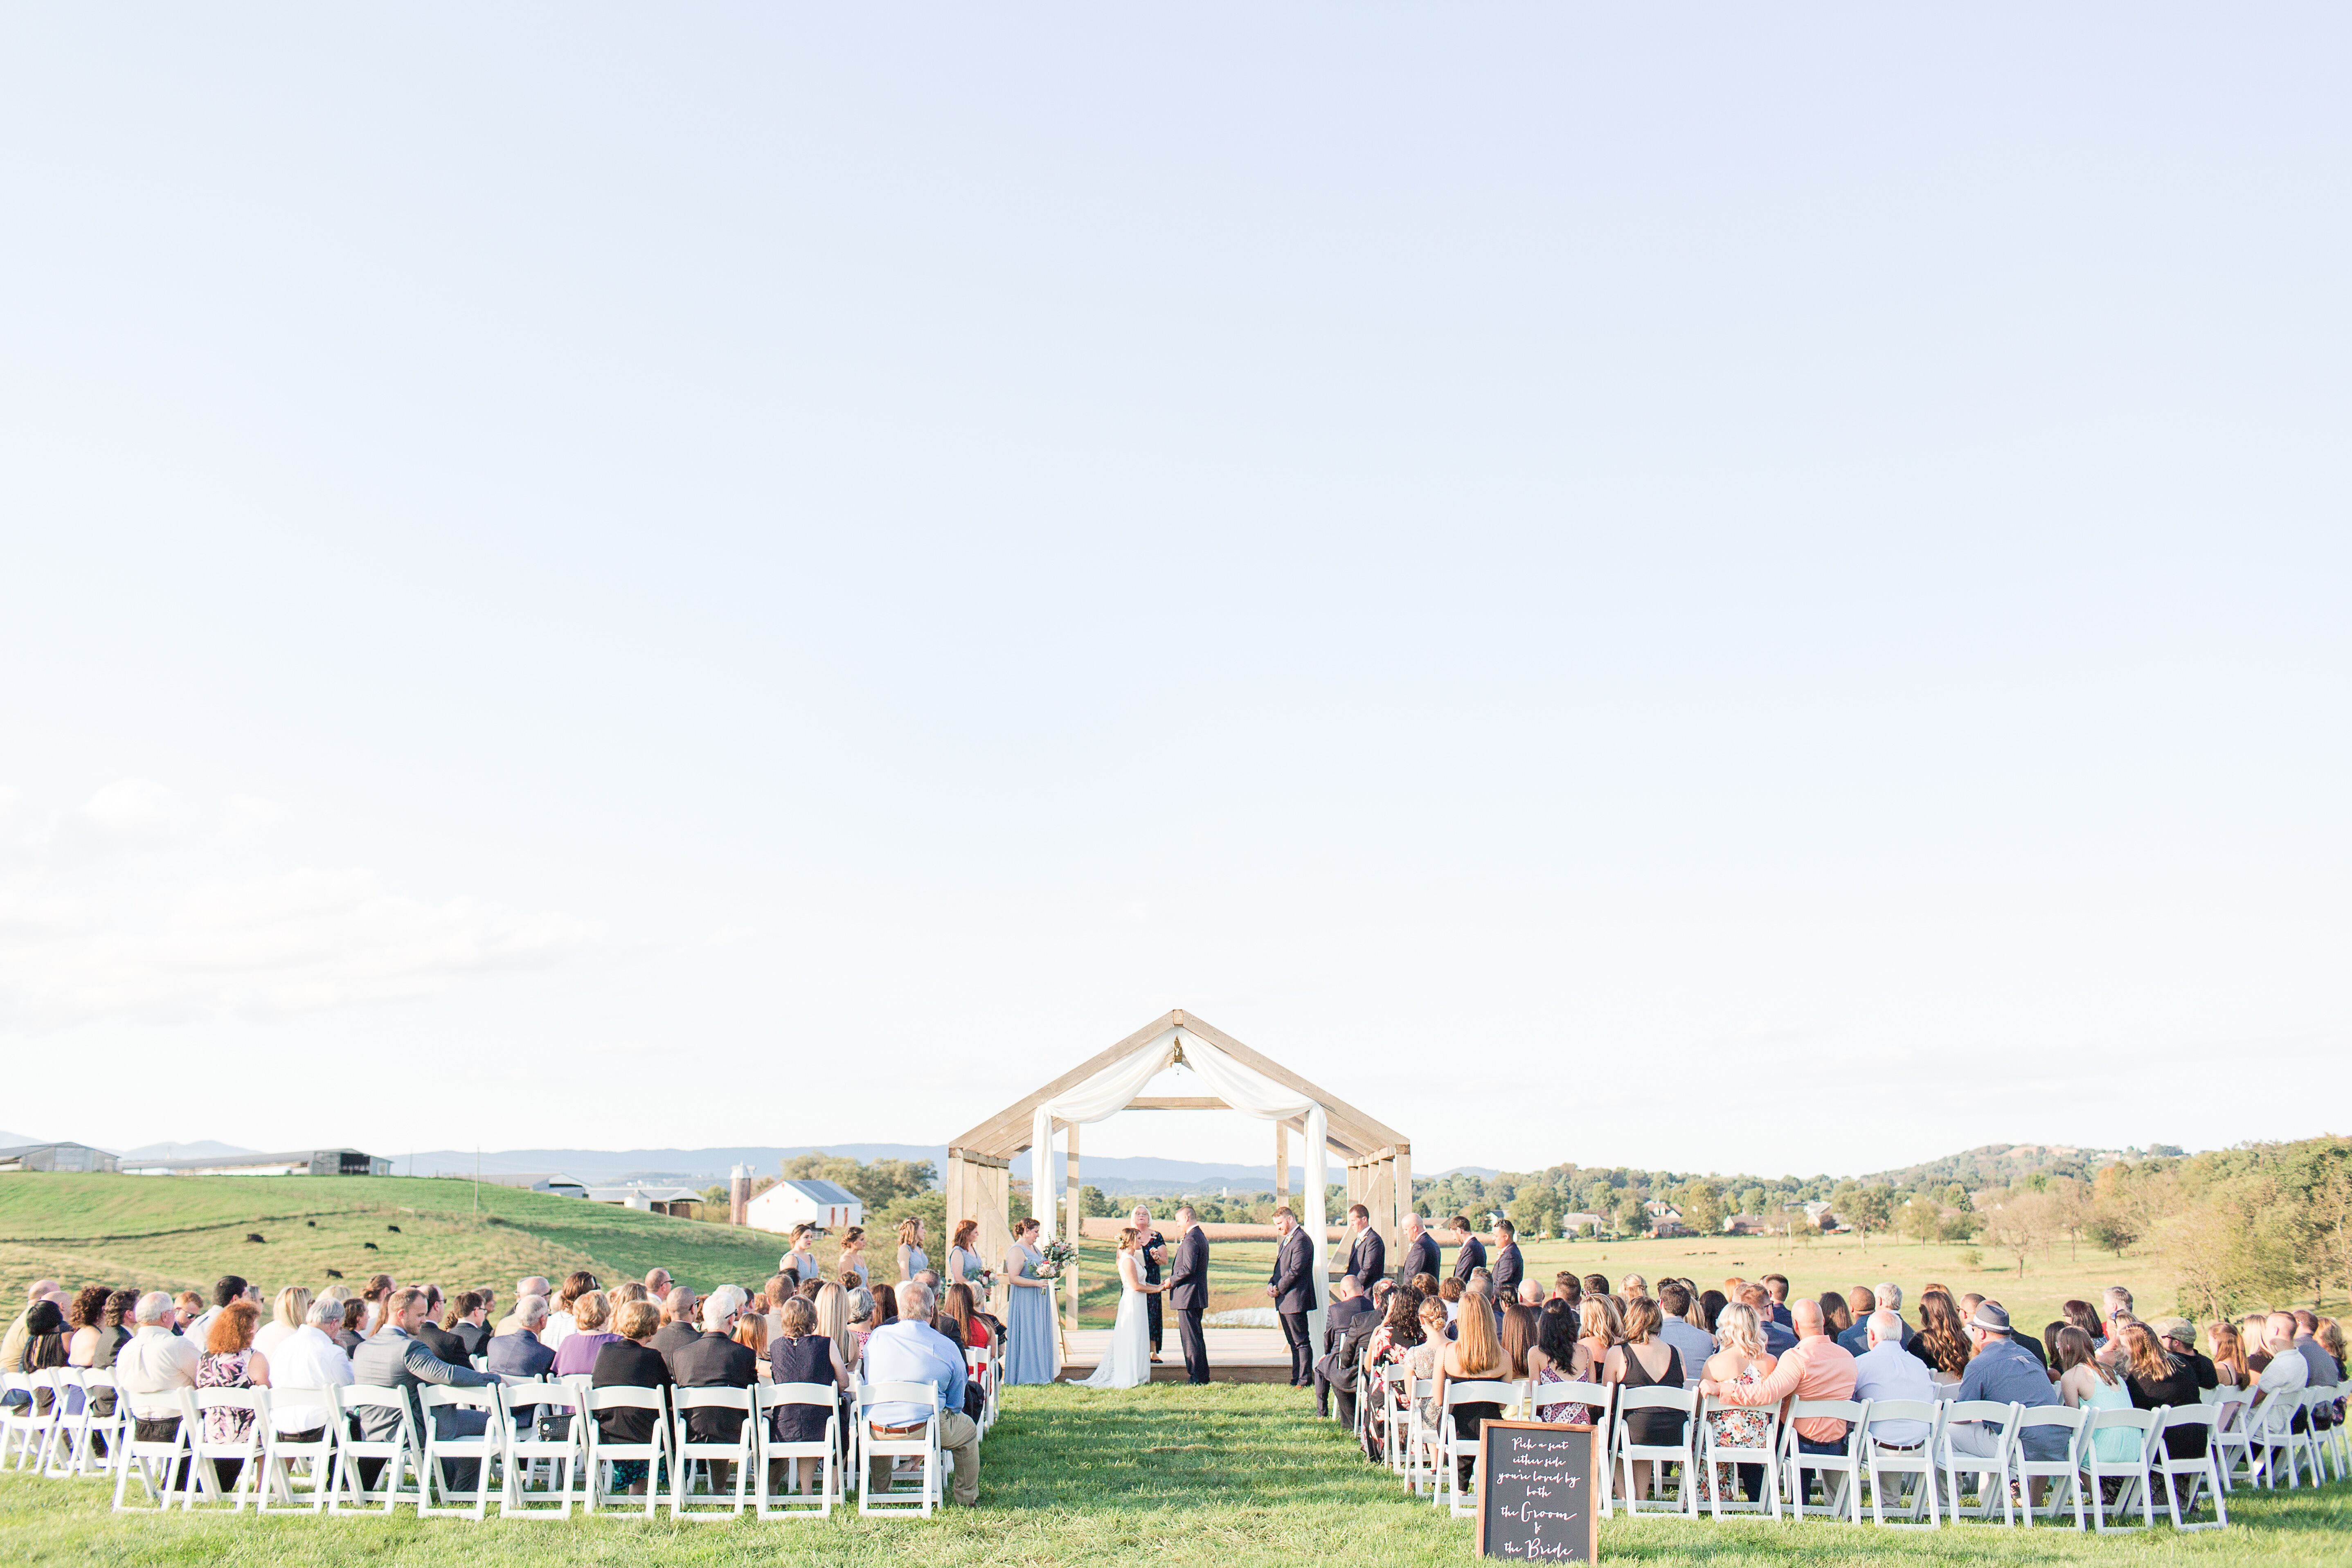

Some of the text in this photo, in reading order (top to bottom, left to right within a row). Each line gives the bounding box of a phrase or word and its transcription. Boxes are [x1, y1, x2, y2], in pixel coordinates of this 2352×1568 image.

[1512, 1437, 1537, 1450] Pick
[1548, 1441, 1568, 1451] seat
[1513, 1454, 1566, 1467] either side
[1533, 1471, 1563, 1483] loved
[1565, 1472, 1580, 1487] by
[1527, 1485, 1551, 1497] both
[1501, 1501, 1577, 1523] the Groom
[1535, 1522, 1542, 1534] &
[1504, 1538, 1573, 1559] the Bride
